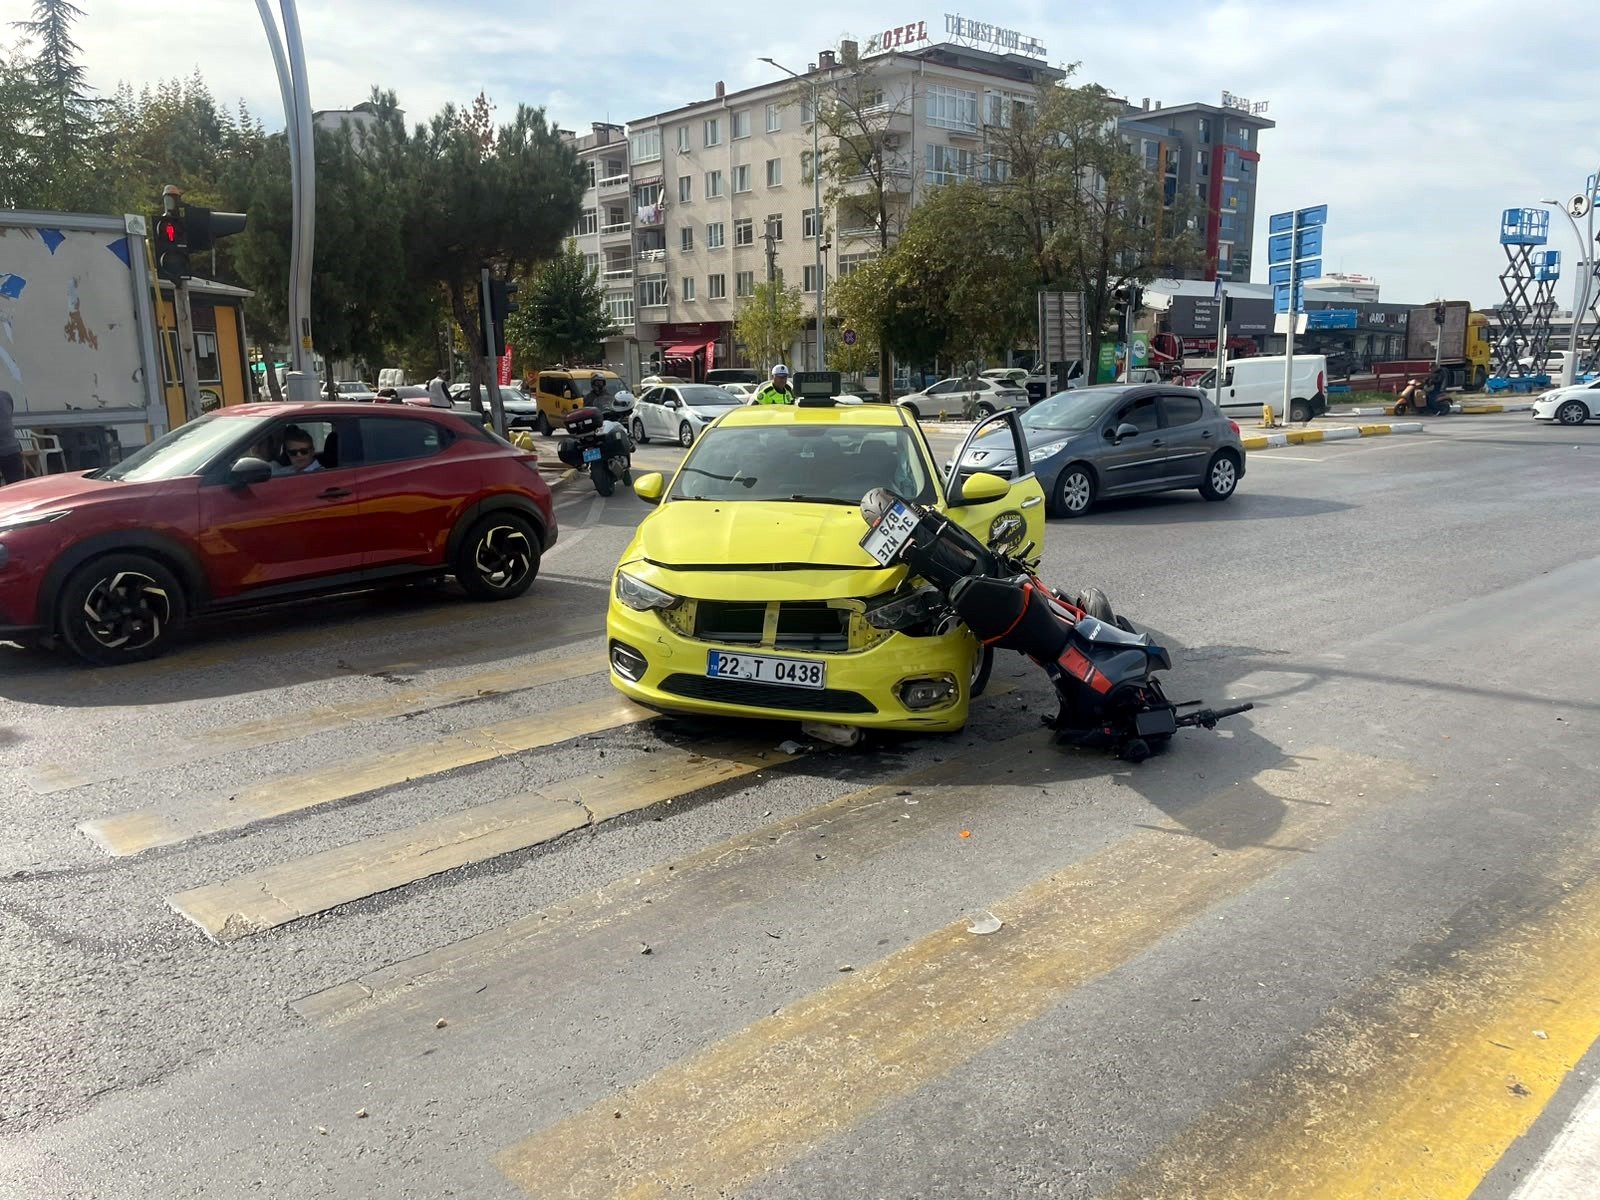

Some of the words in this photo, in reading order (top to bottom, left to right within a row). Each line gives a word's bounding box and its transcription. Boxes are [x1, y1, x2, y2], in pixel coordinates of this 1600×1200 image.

[879, 512, 900, 537] 879
[897, 516, 914, 533] 34
[877, 535, 899, 561] MZE
[719, 656, 739, 676] 22
[754, 659, 764, 678] T
[775, 662, 820, 684] 0438
